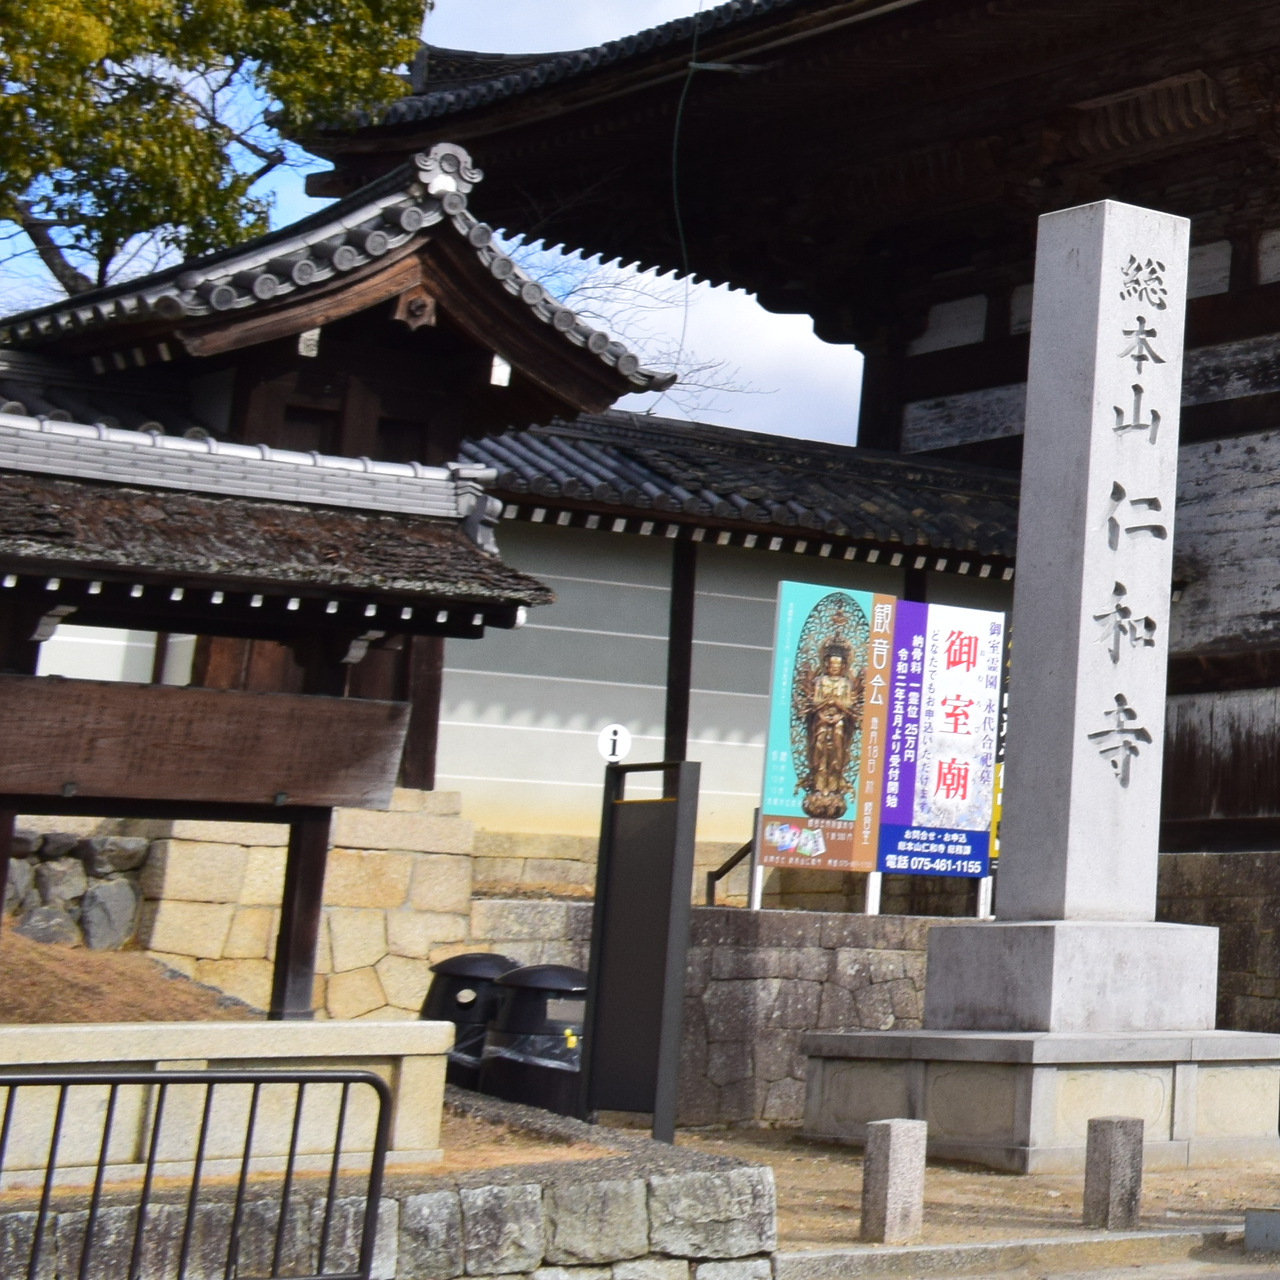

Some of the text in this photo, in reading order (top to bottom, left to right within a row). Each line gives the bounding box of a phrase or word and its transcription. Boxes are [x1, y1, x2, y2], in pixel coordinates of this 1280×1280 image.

[1086, 254, 1168, 789] 総本山仁和寺
[869, 603, 893, 706] 観音会
[910, 634, 925, 675] 納骨料
[885, 648, 909, 808] 令和二年五月より受付開始
[903, 722, 918, 763] 25万円
[933, 630, 979, 801] 御室廟
[885, 854, 909, 870] 電話
[910, 856, 982, 874] 075-461-1155
